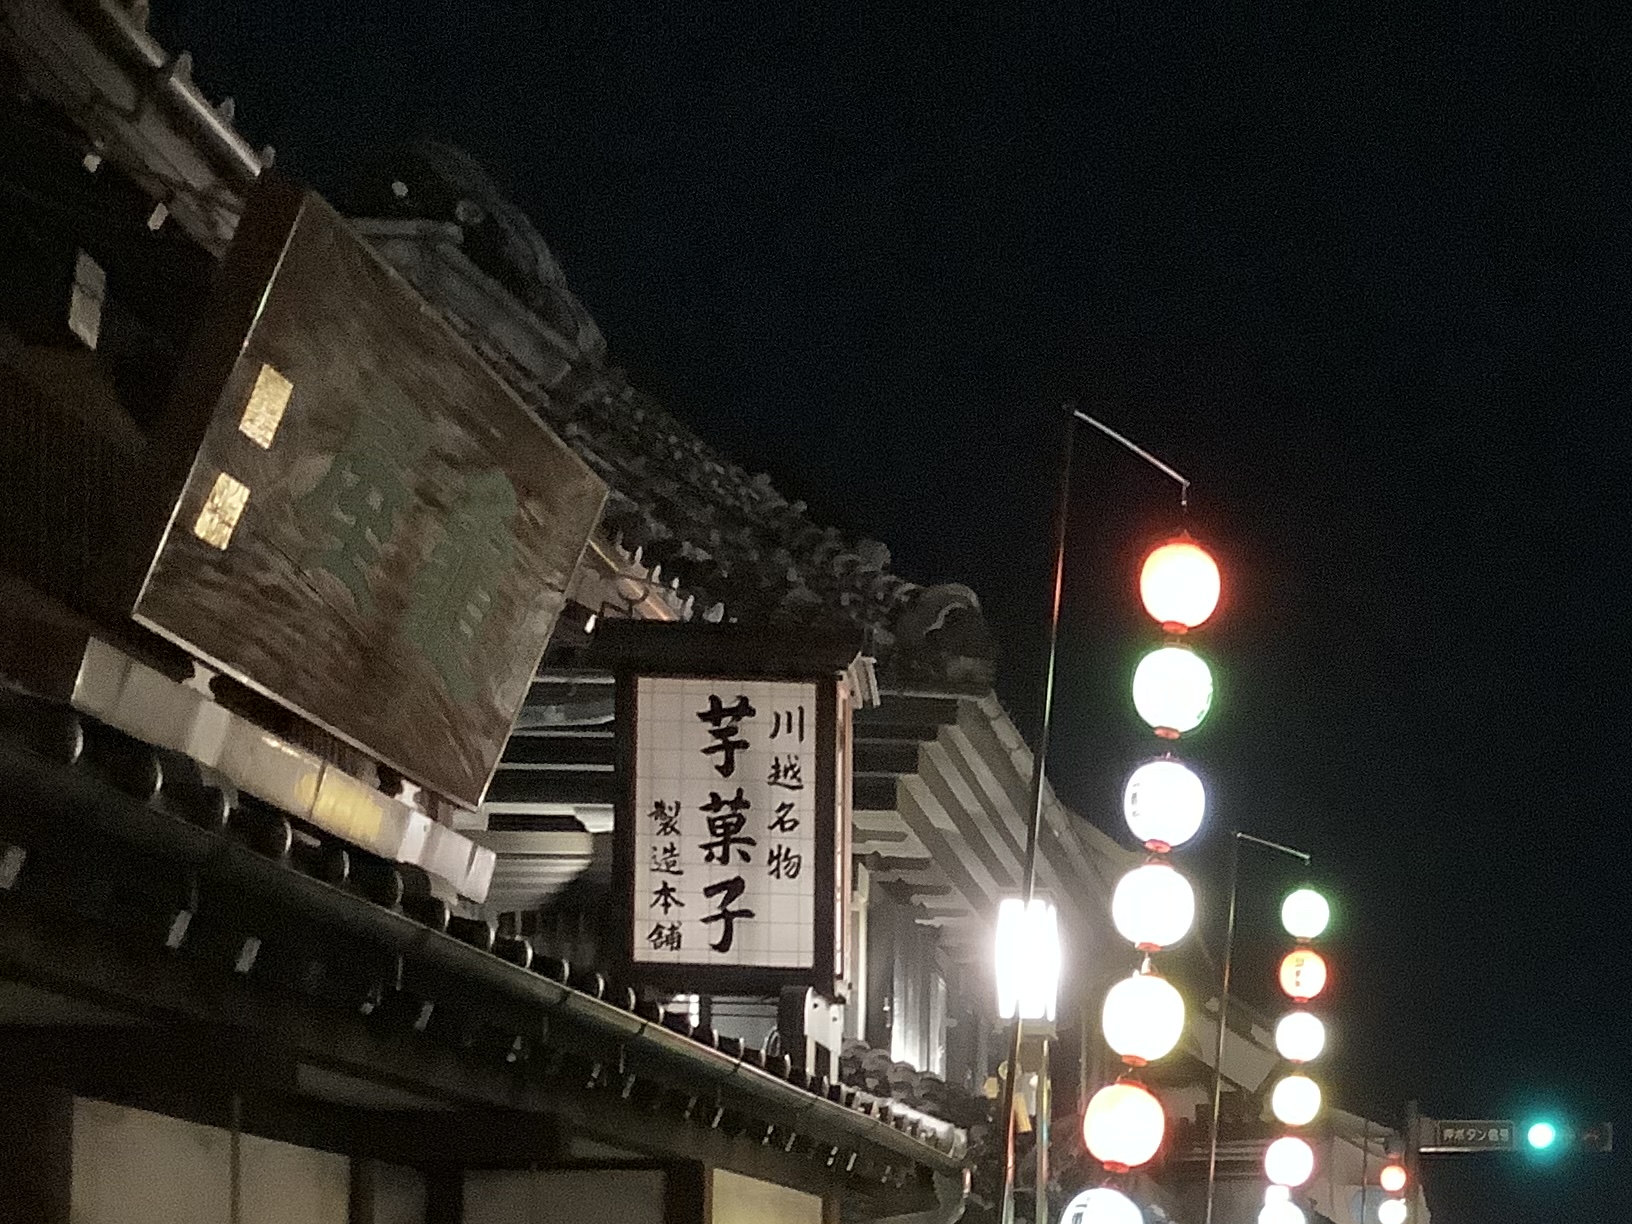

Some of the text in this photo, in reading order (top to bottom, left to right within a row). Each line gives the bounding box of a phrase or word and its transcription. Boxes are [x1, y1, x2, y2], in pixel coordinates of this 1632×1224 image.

[647, 799, 685, 953] 製造本舗
[696, 694, 757, 953] 芋菓子
[766, 705, 804, 880] 川越名物
